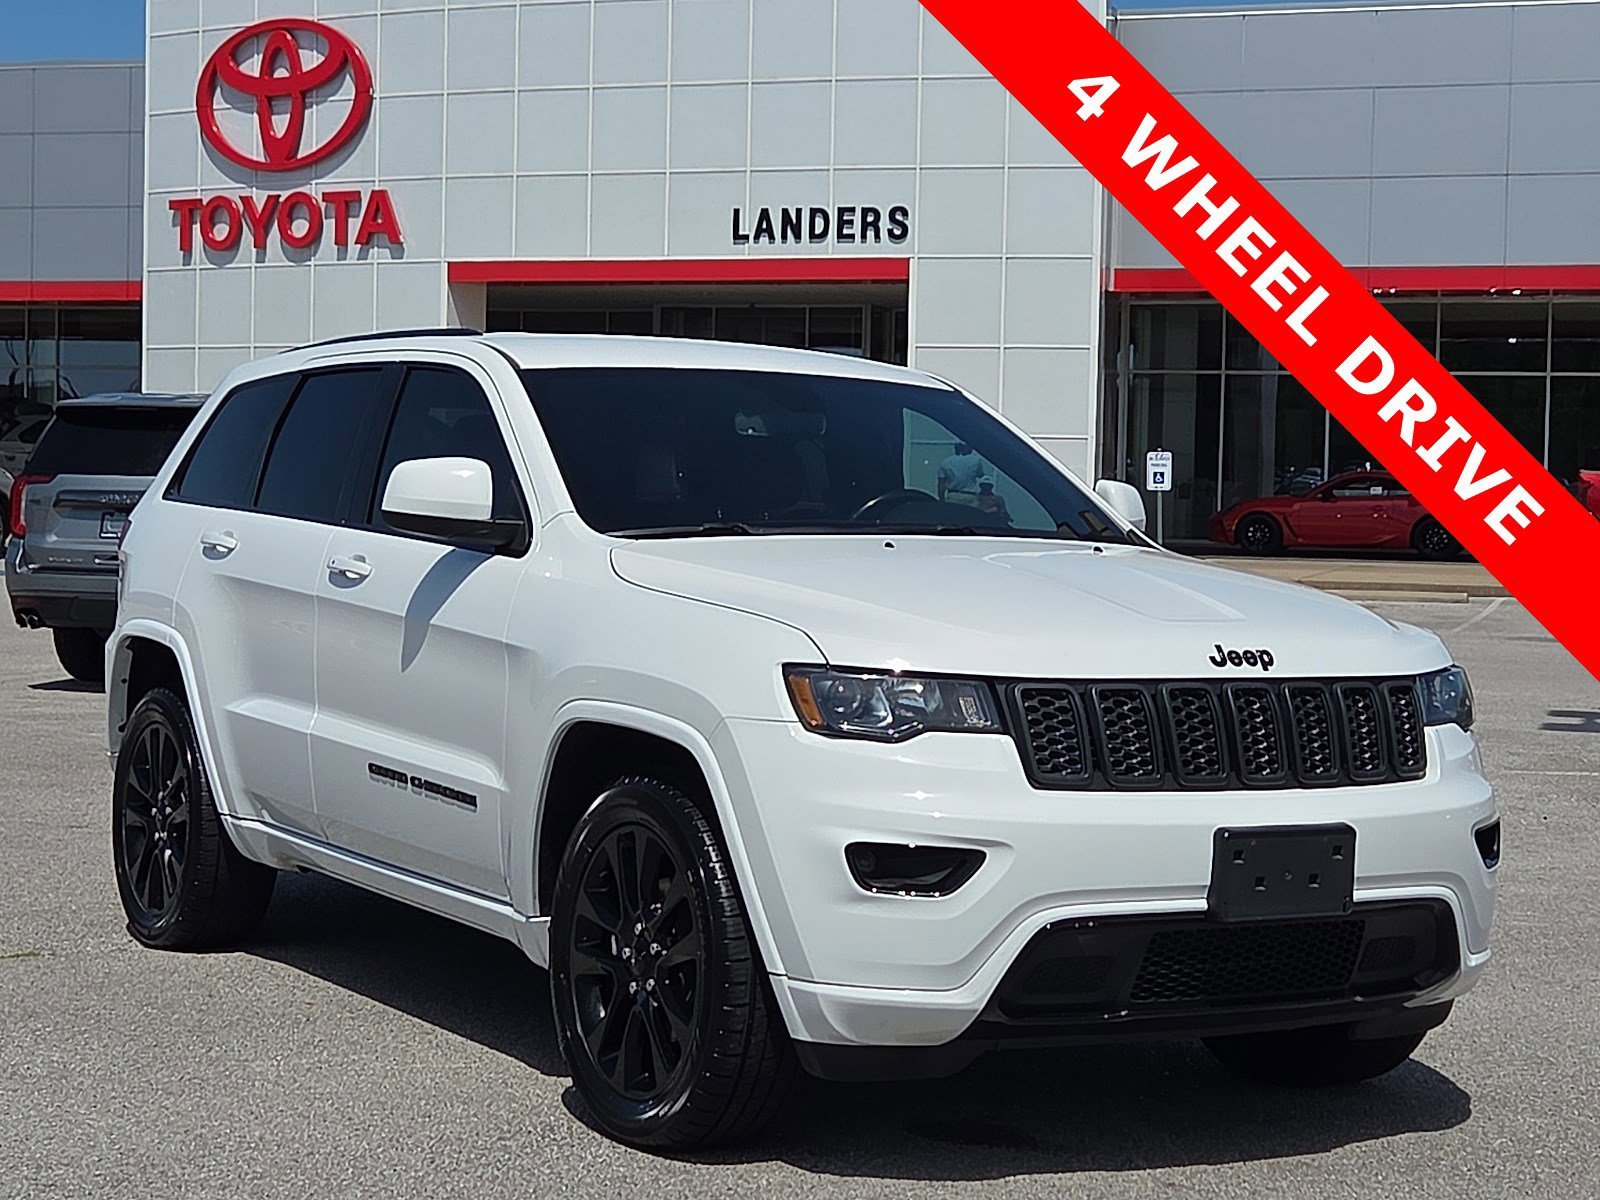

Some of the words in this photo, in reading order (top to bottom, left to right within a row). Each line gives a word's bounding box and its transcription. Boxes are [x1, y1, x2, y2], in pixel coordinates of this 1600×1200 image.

[169, 189, 404, 252] TOYOTA
[733, 206, 909, 243] LANDERS
[1208, 644, 1275, 672] Jeep
